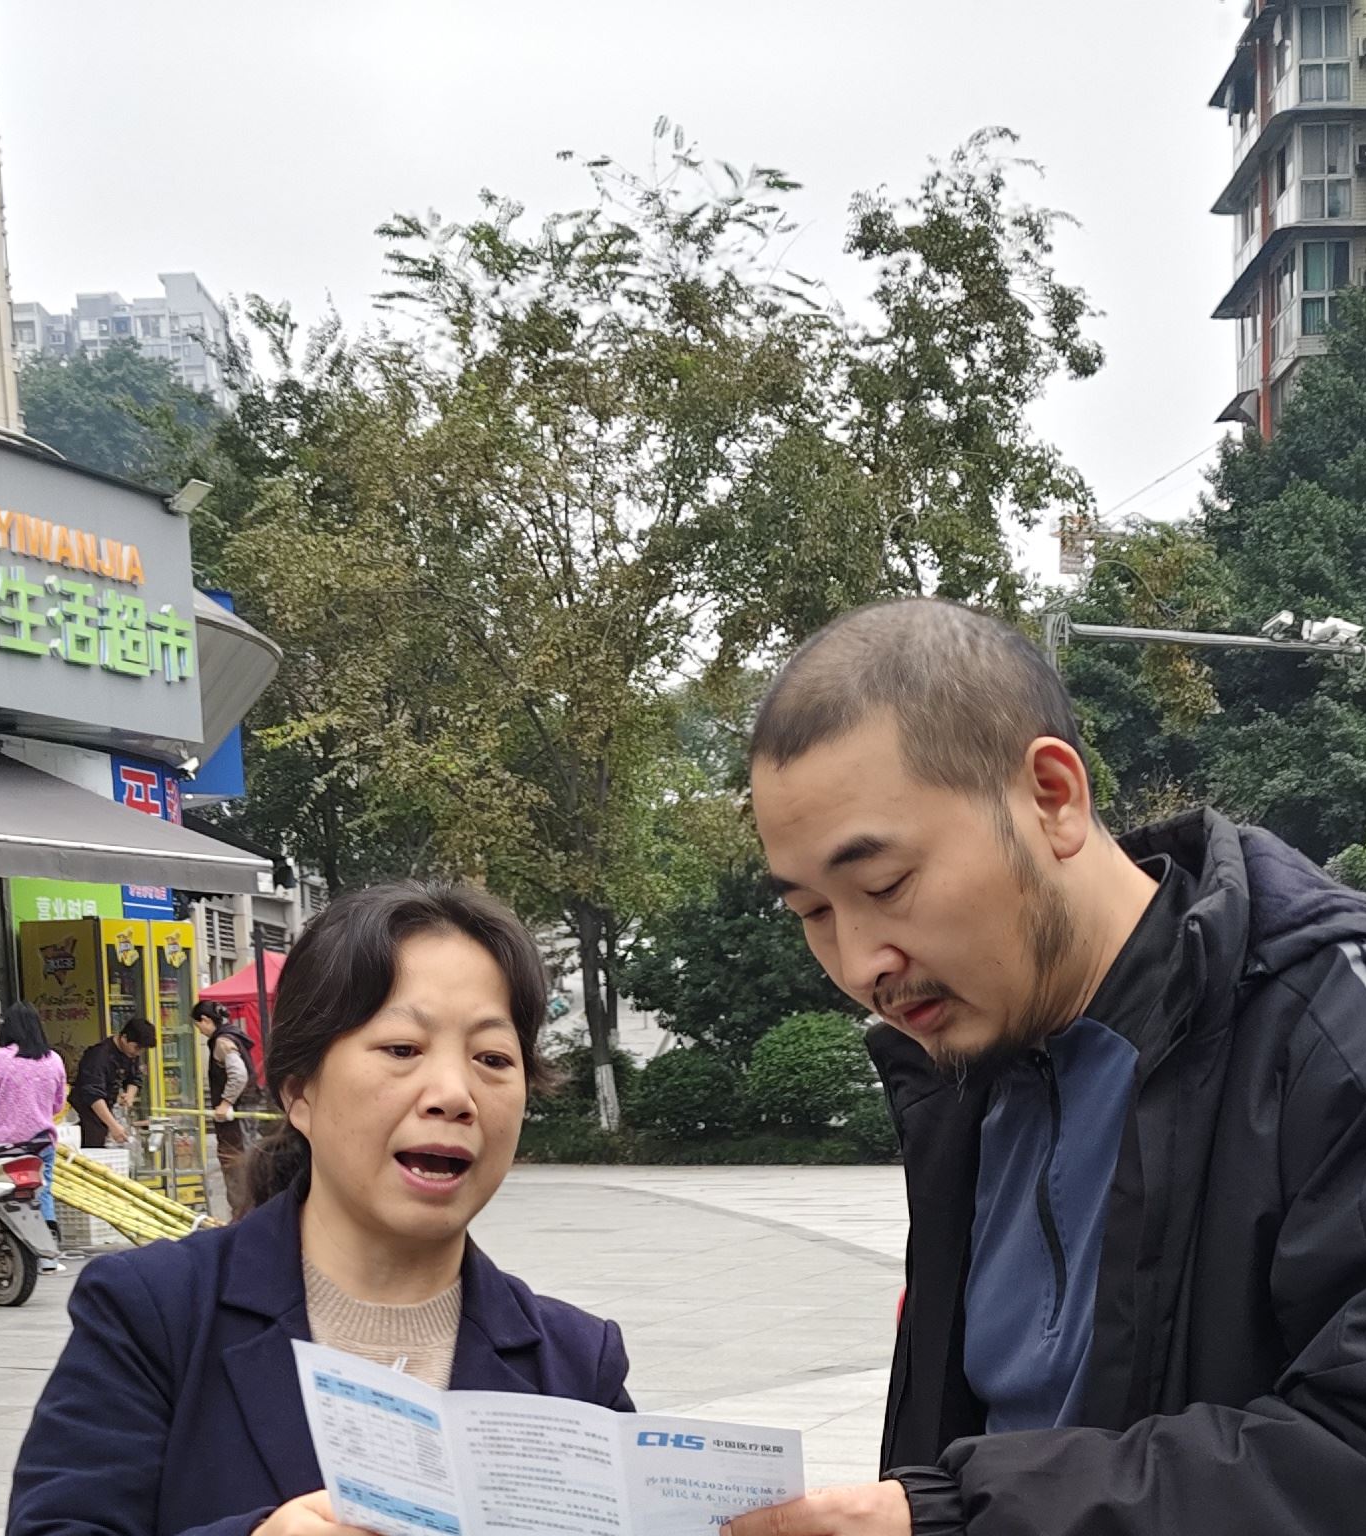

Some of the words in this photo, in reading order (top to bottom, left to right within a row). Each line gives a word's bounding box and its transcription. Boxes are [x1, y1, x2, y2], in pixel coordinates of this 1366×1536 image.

[636, 1431, 706, 1451] CHS
[712, 1438, 784, 1454] 中国医疗保障
